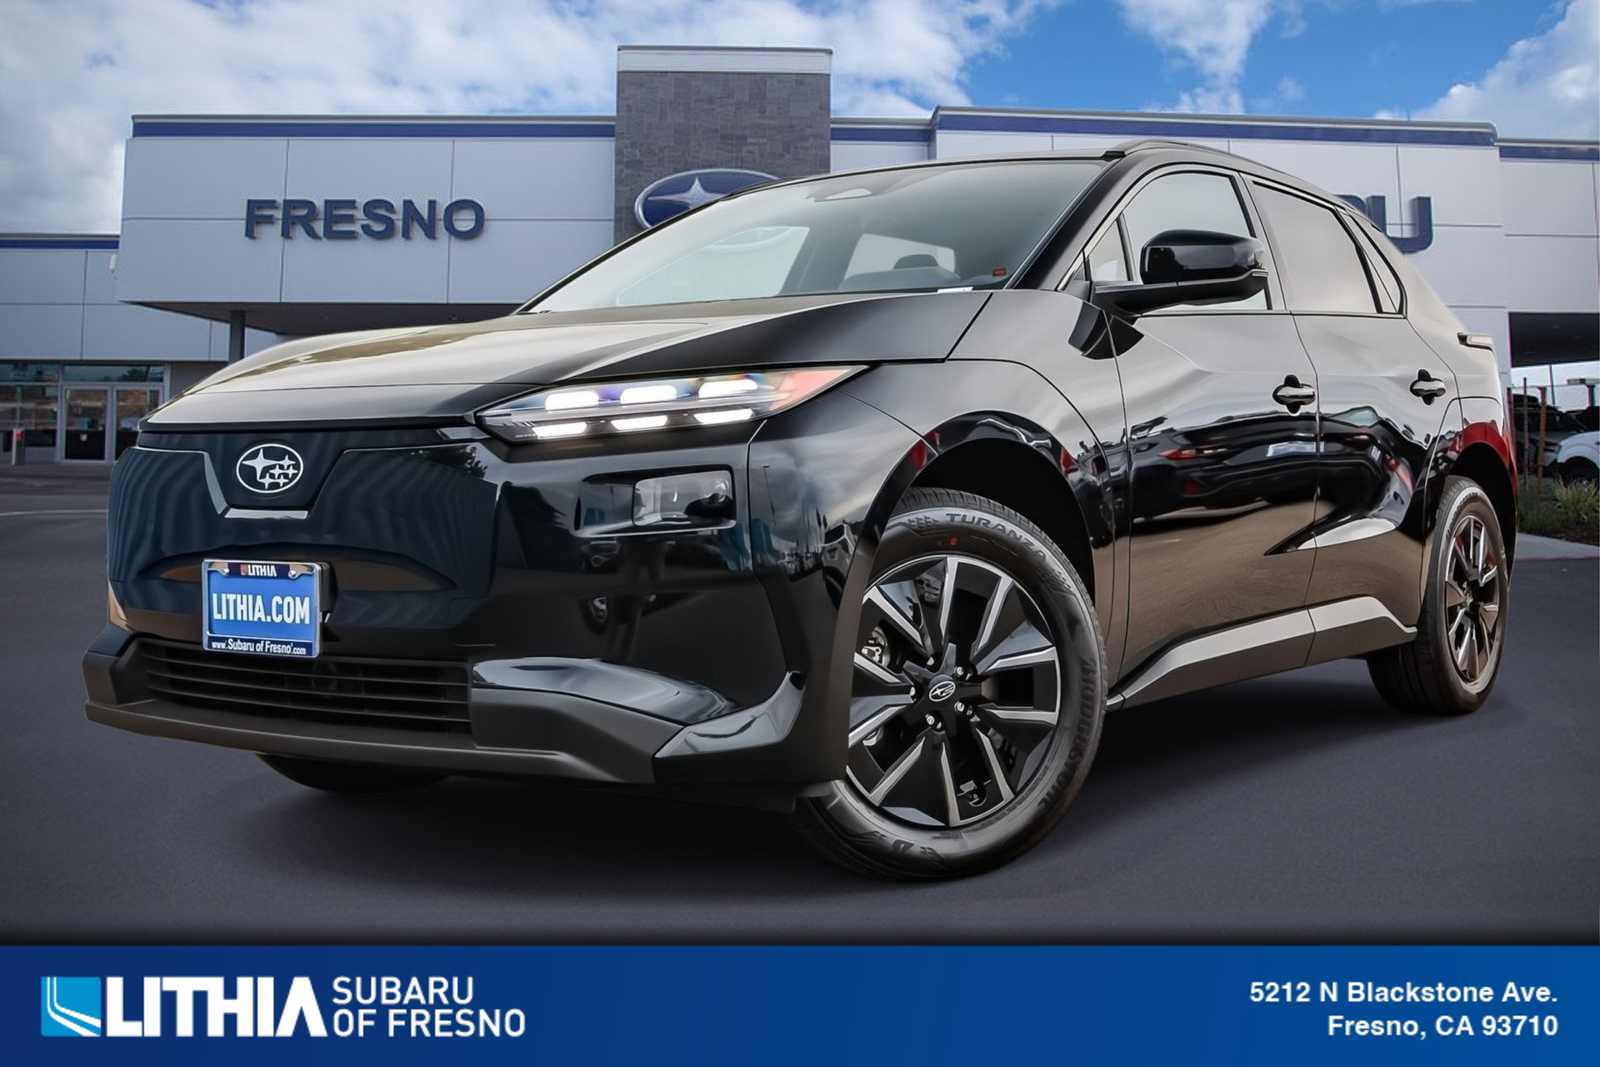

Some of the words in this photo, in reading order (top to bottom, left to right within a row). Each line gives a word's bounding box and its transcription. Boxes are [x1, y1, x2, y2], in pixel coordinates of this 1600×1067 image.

[245, 199, 486, 240] FRESNO
[946, 513, 1046, 561] TURANZA
[247, 564, 277, 577] LITHIA
[212, 593, 310, 625] LITHIA.COM
[255, 640, 264, 652] of
